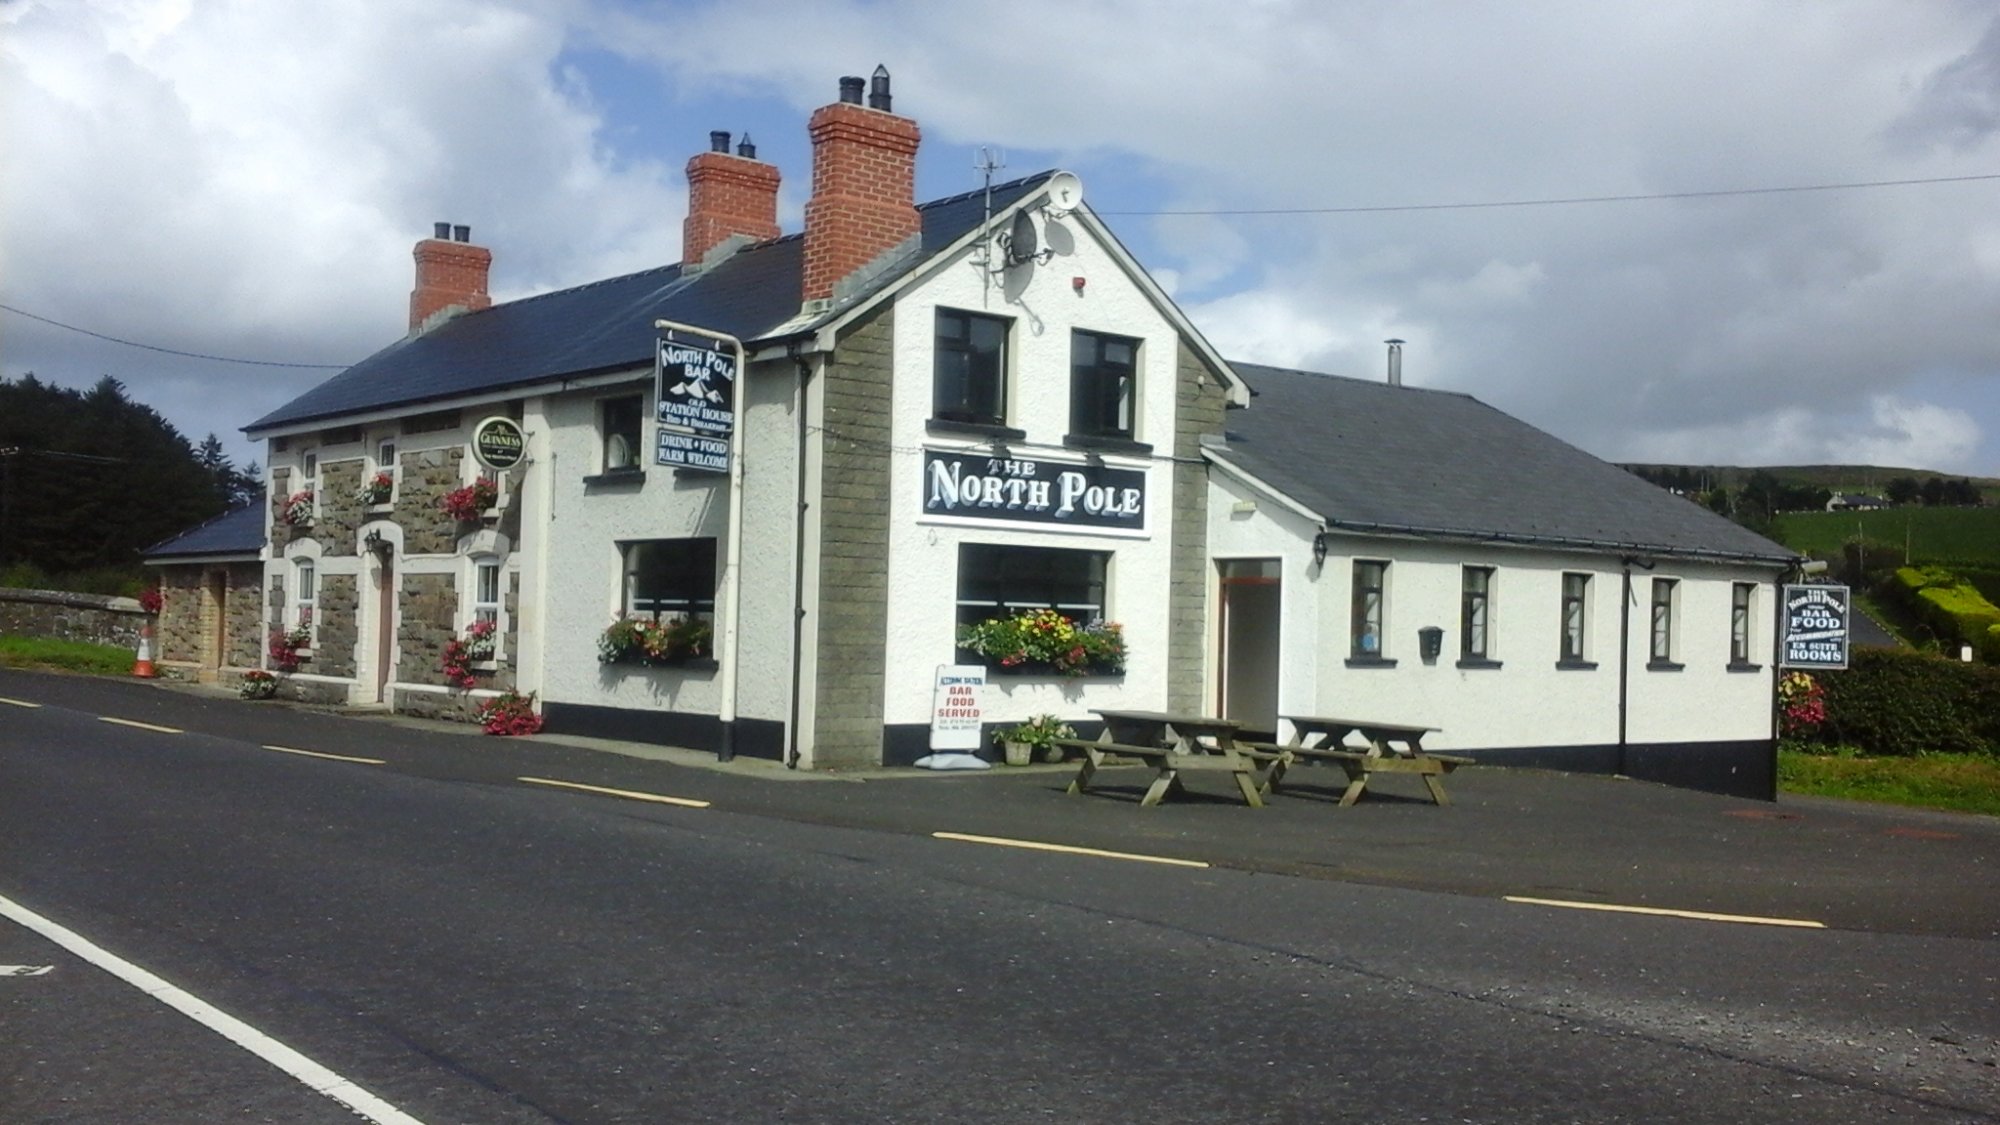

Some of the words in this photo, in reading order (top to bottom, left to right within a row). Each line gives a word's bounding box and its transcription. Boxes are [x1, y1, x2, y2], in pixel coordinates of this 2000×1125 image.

[661, 346, 702, 367] NORTH
[706, 350, 734, 381] POLE
[685, 363, 710, 381] BAR
[659, 401, 700, 417] STATION
[480, 432, 521, 447] GUINNESS
[661, 434, 693, 449] DRINK
[700, 440, 726, 453] FOOD
[658, 448, 684, 462] WARM
[687, 452, 727, 467] WELCOME
[988, 458, 1035, 478] THE
[928, 459, 1050, 509] NORTH
[1055, 471, 1140, 518] POLE
[1791, 617, 1840, 628] FOOD
[1790, 649, 1841, 661] ROOMS
[949, 686, 972, 695] BAR
[946, 697, 974, 706] FOOD
[938, 708, 980, 718] SERVED
